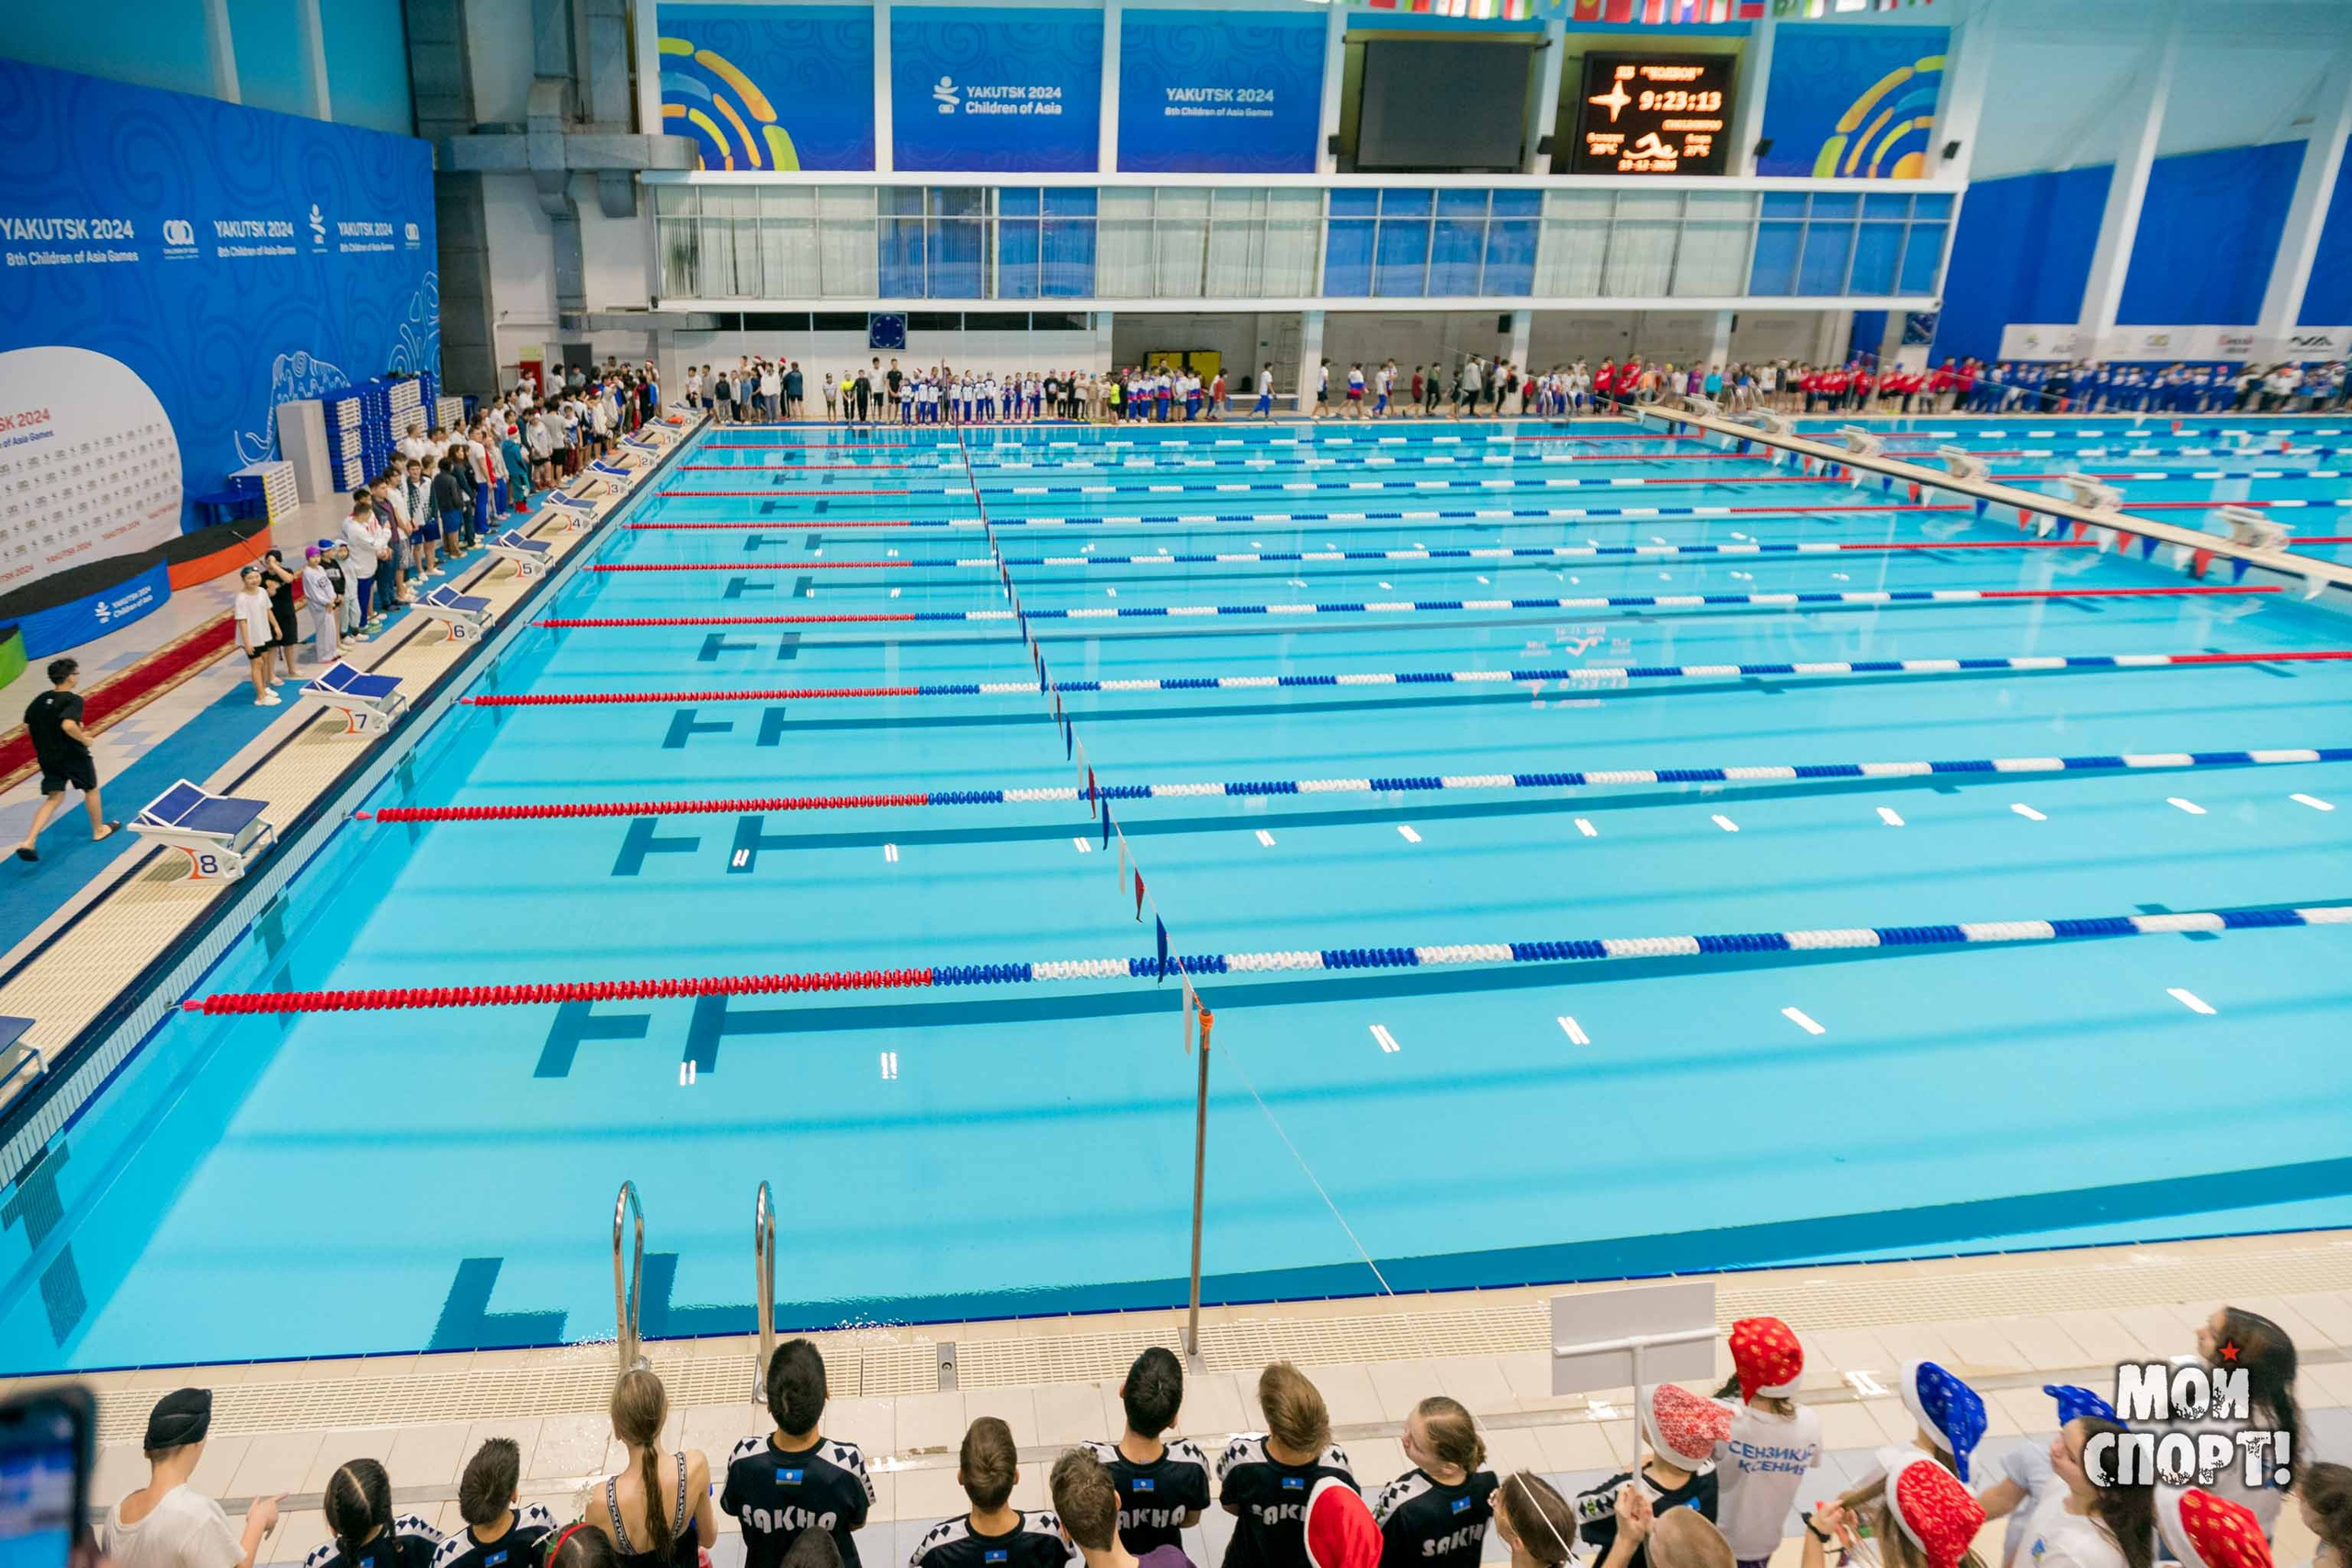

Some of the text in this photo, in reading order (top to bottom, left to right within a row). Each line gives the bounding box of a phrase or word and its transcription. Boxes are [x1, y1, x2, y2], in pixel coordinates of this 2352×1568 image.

[967, 86, 1062, 98] YAKUTSK 2024
[1166, 88, 1274, 102] YAKUTSK 2024
[966, 102, 1062, 114] Children of Asia
[1639, 90, 1722, 112] 9:23:13
[1165, 107, 1273, 117] 8th Children of Asia Games
[0, 218, 134, 240] YAKUTSK 2024
[214, 220, 294, 238] YAKUTSK 2024
[338, 222, 393, 237] YAKUTSK 2024
[6, 249, 139, 266] 8th Children of Asia Games
[231, 246, 256, 257] Children
[18, 408, 50, 427] 2024
[13, 434, 28, 446] Asia
[29, 429, 54, 442] Games
[611, 485, 618, 493] 3
[573, 518, 580, 527] 4
[523, 564, 532, 574] 5
[454, 625, 465, 638] 6
[355, 714, 367, 728] 7
[200, 855, 218, 873] 8
[742, 1504, 837, 1534] SAKHA
[1116, 1505, 1186, 1529] AKHA
[1422, 1523, 1484, 1557] SAKH
